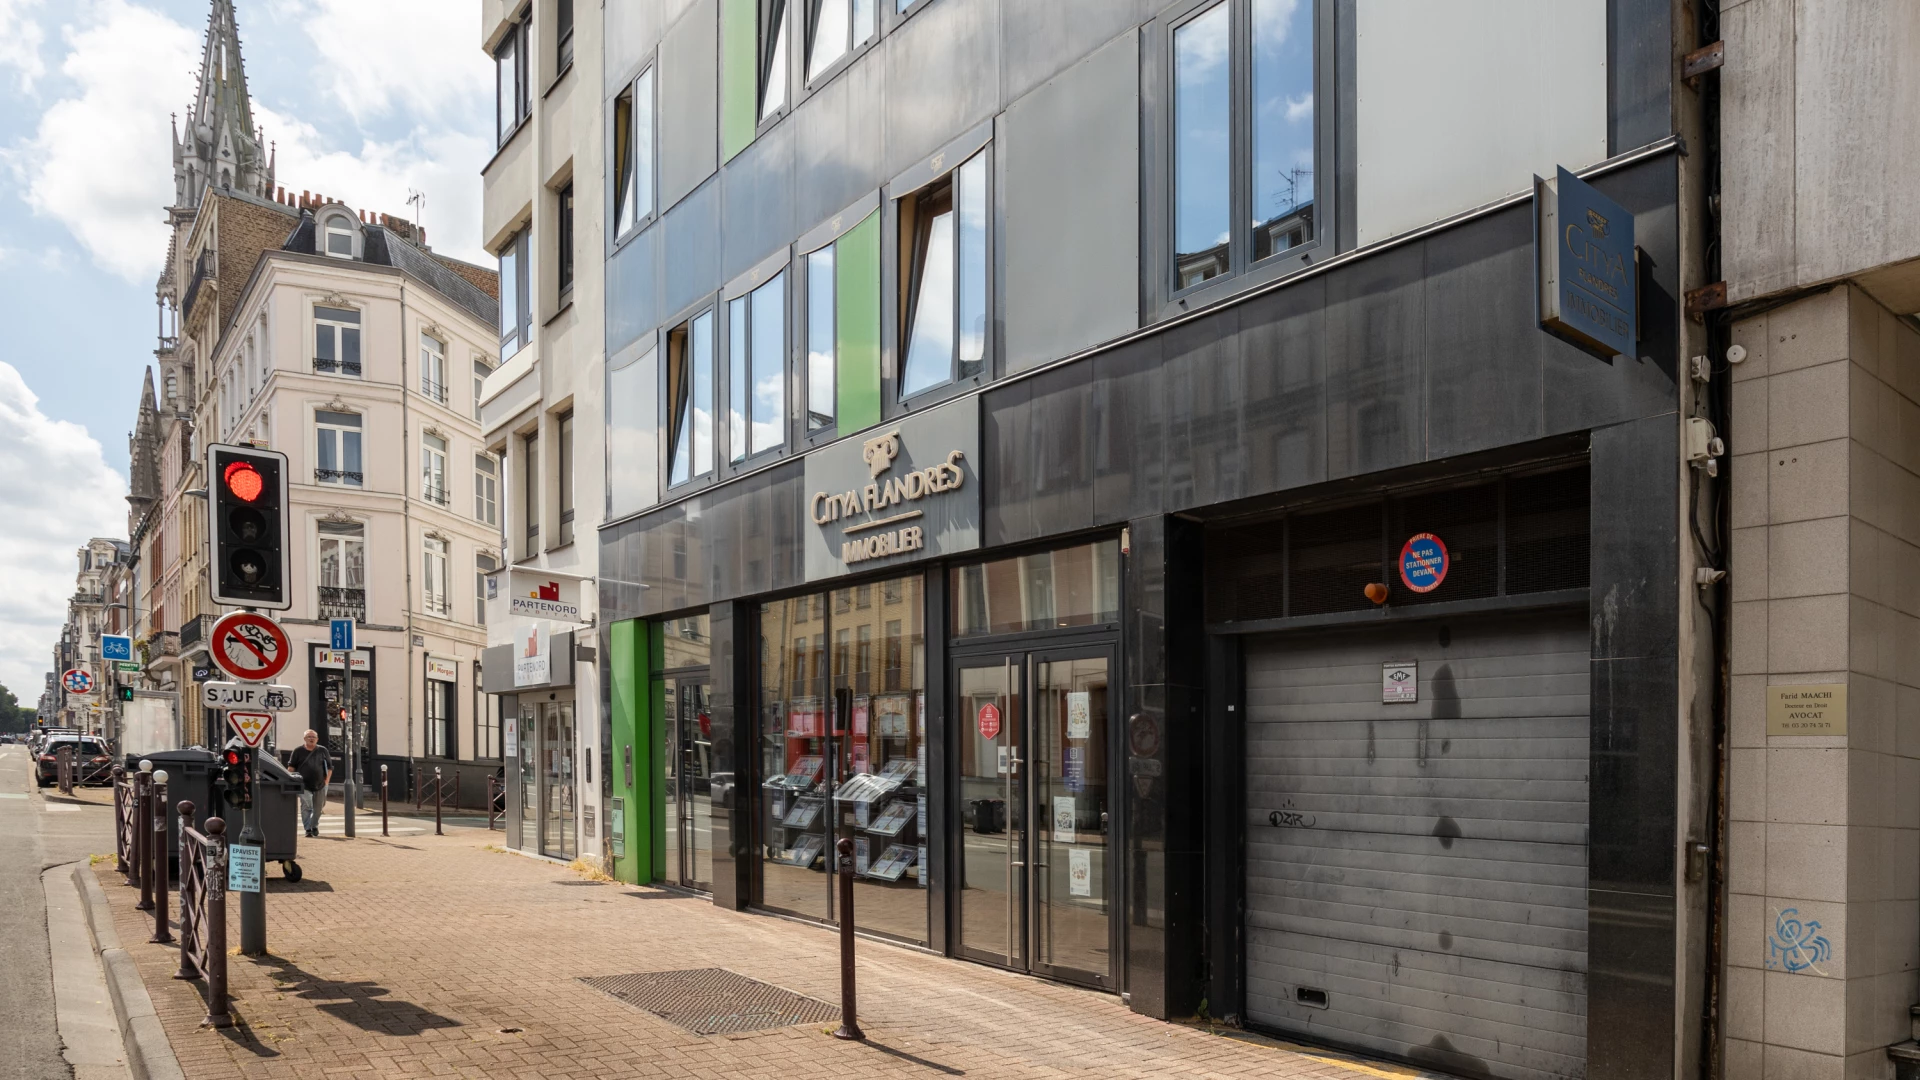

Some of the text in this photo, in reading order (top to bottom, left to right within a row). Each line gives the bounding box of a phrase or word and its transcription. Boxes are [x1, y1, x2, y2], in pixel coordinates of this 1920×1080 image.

[1566, 223, 1628, 286] CITYA
[1578, 267, 1618, 300] FLANDRES
[1566, 290, 1629, 337] IMMOBILIER
[810, 450, 964, 525] CITYA FLANDRES
[842, 526, 923, 564] IMMOBILIER
[1412, 549, 1433, 559] NE PAS
[1406, 557, 1442, 569] STATIONNER
[1412, 567, 1436, 578] DEVANT
[513, 599, 577, 615] PARTENORD
[334, 656, 365, 666] Mogan
[518, 660, 545, 672] PARTENORD
[1393, 672, 1406, 680] SMF
[1800, 691, 1832, 699] MAACHI
